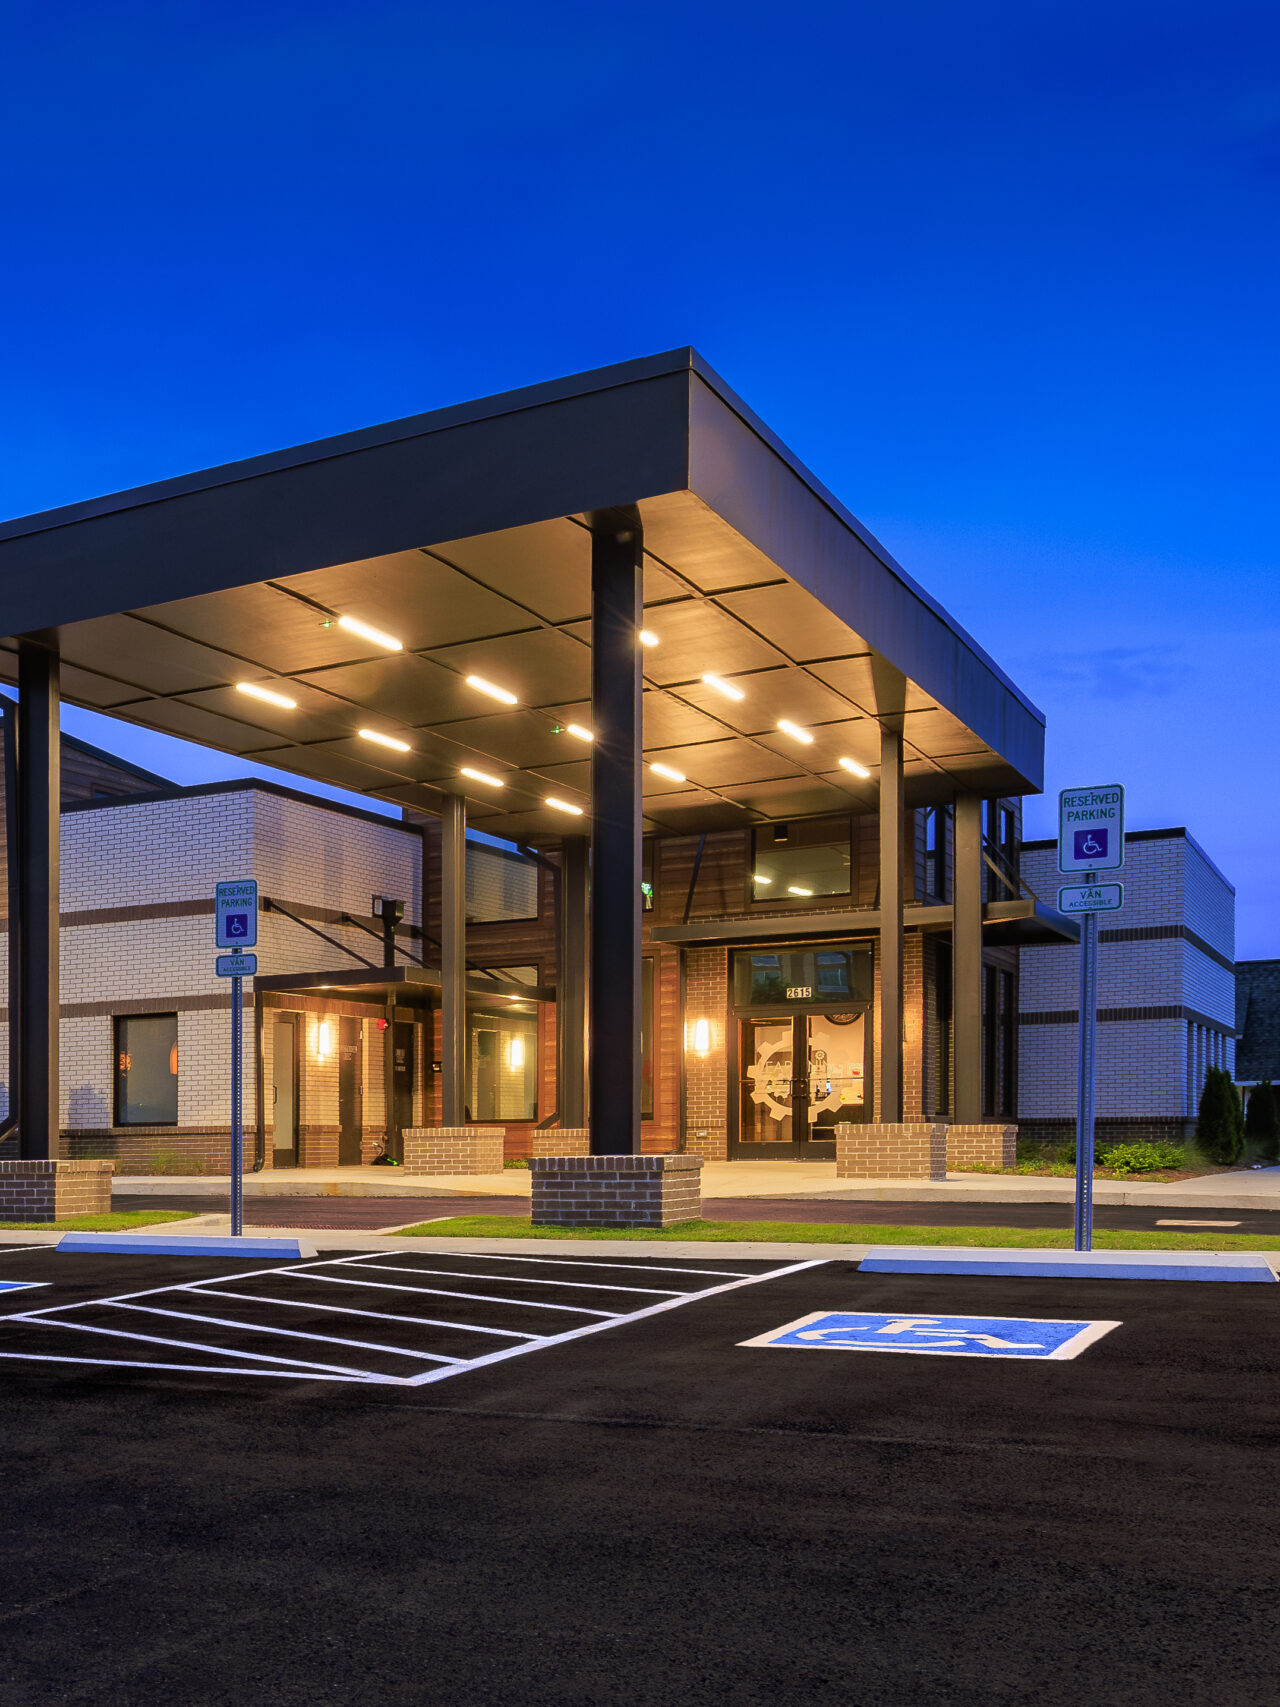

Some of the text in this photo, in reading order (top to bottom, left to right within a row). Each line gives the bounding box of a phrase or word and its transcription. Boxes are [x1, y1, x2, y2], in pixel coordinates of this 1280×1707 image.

[1063, 792, 1119, 808] RESERVED
[1067, 807, 1116, 822] PARKING
[219, 886, 254, 896] RESERVED
[1080, 890, 1102, 899] VAN
[221, 897, 252, 908] PARKING
[1069, 899, 1112, 908] ACCESSIBLE
[230, 958, 244, 966] VAN
[787, 987, 811, 998] 2615
